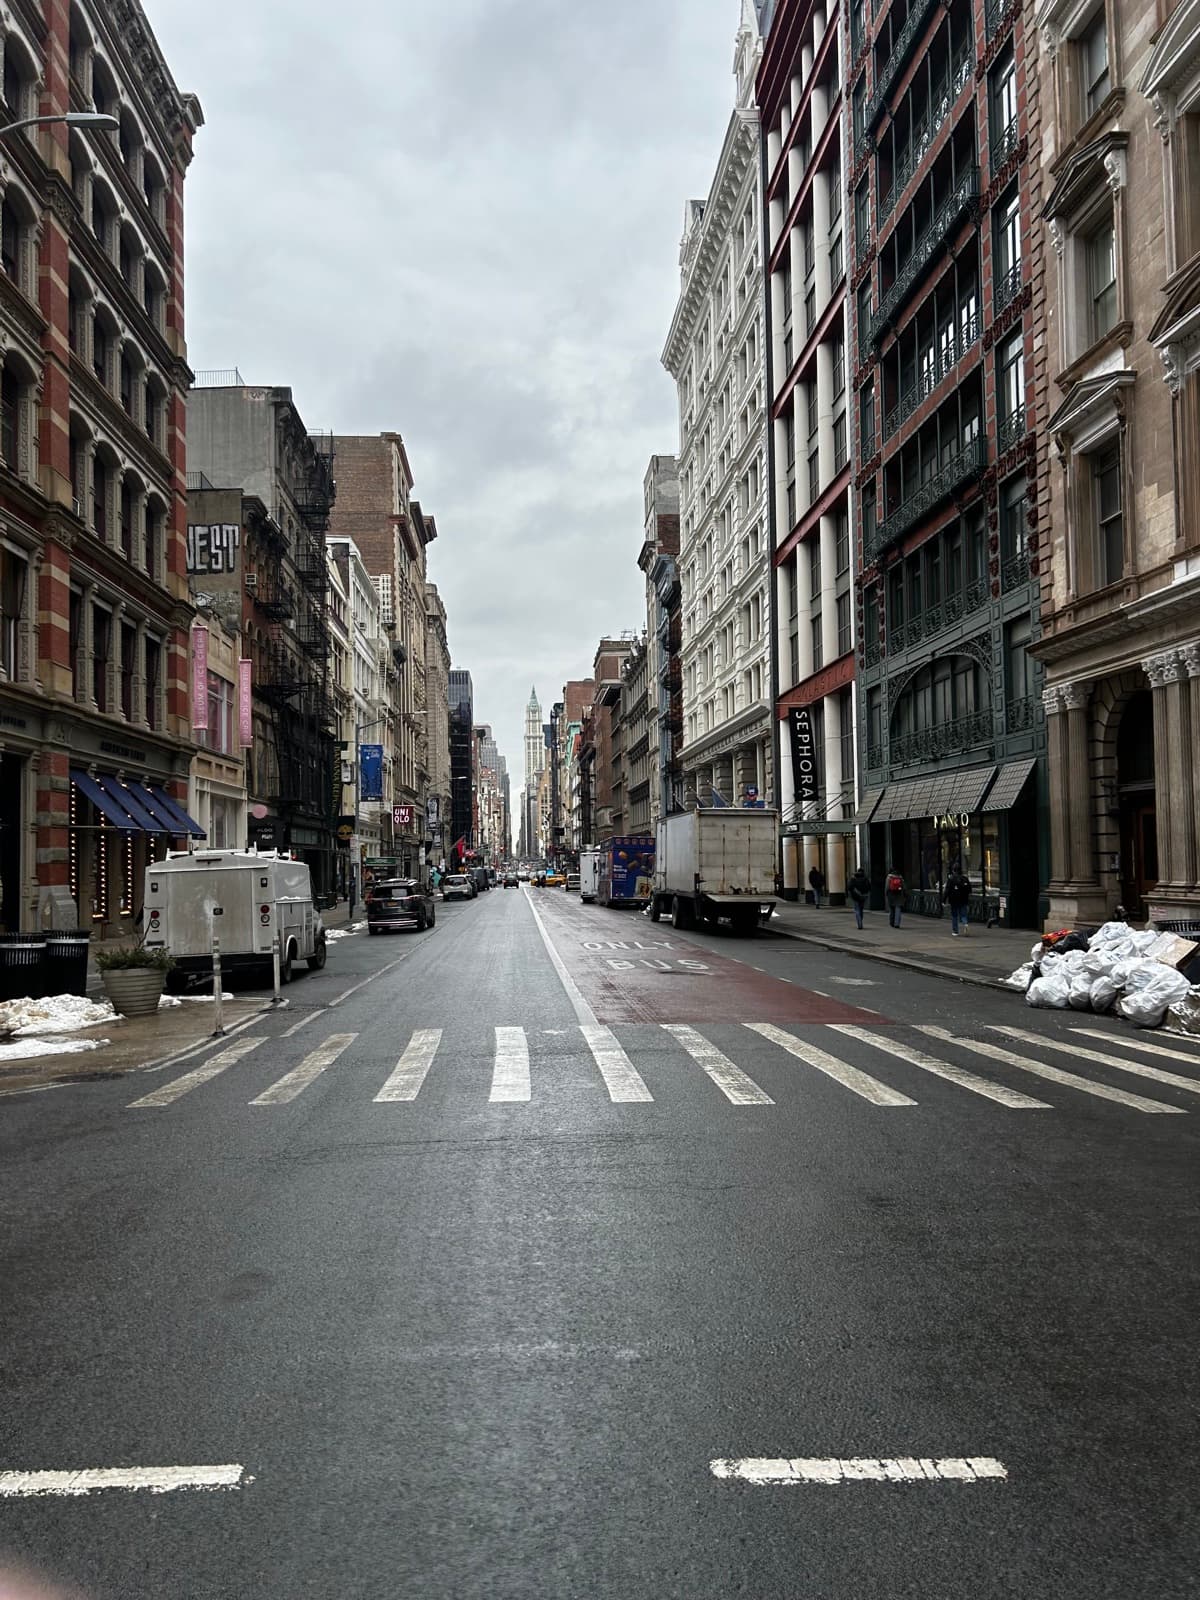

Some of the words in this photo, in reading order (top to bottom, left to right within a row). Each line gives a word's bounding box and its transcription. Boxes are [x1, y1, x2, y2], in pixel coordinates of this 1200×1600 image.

[795, 711, 815, 798] SEPHORA
[394, 816, 410, 824] QLO
[583, 941, 675, 950] ONLY
[606, 959, 709, 970] BUS
